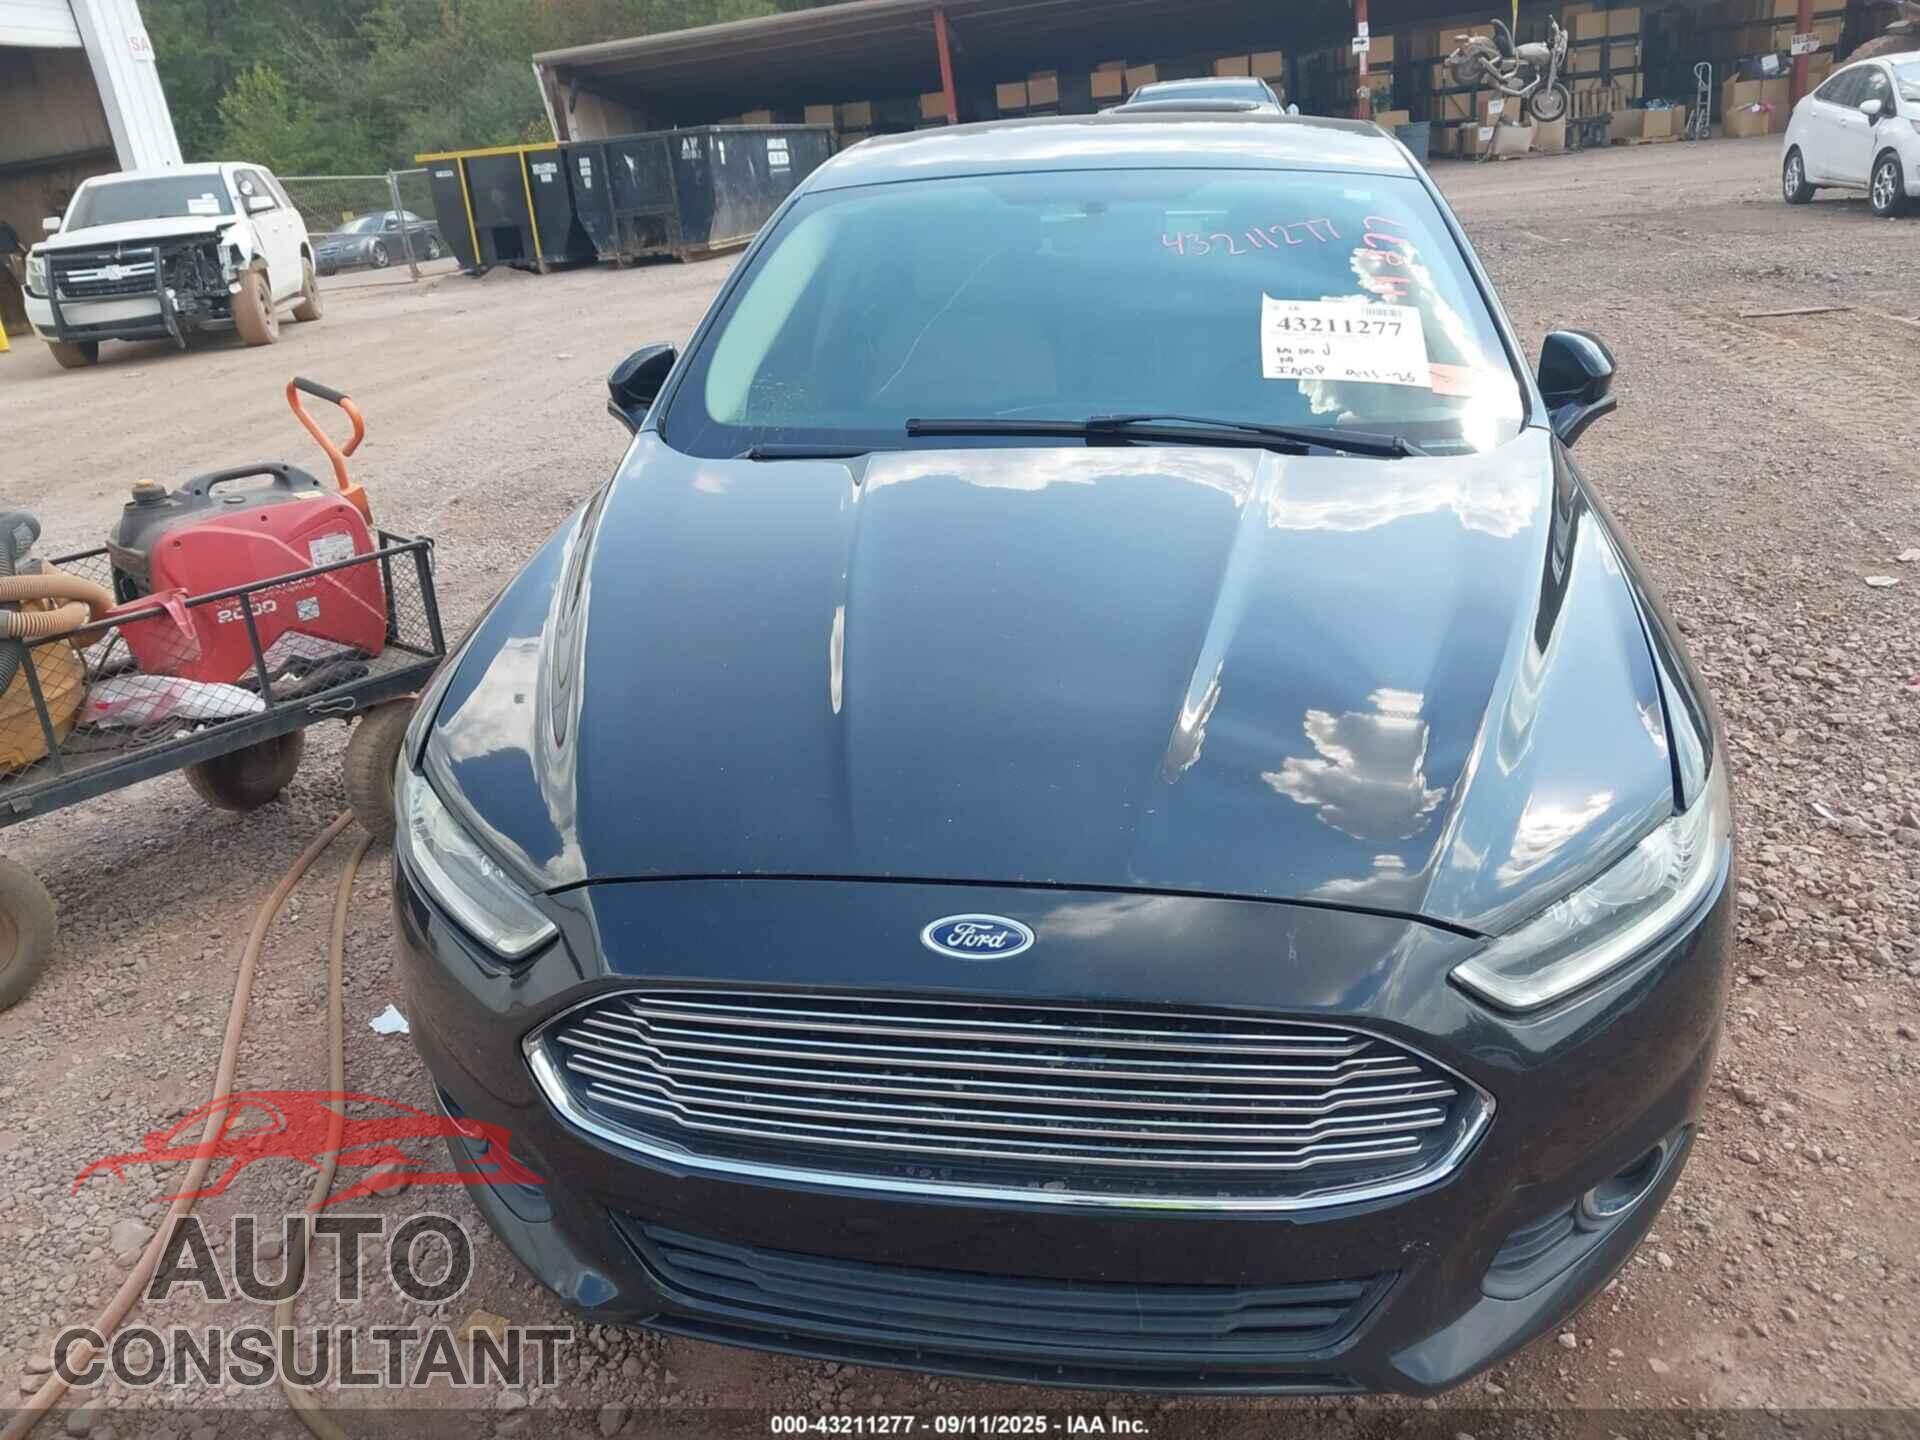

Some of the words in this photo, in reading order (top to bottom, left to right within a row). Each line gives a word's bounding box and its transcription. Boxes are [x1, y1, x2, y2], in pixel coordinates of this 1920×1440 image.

[1161, 217, 1341, 256] 43211277
[1276, 316, 1402, 336] 43211277
[947, 922, 1009, 949] Ford
